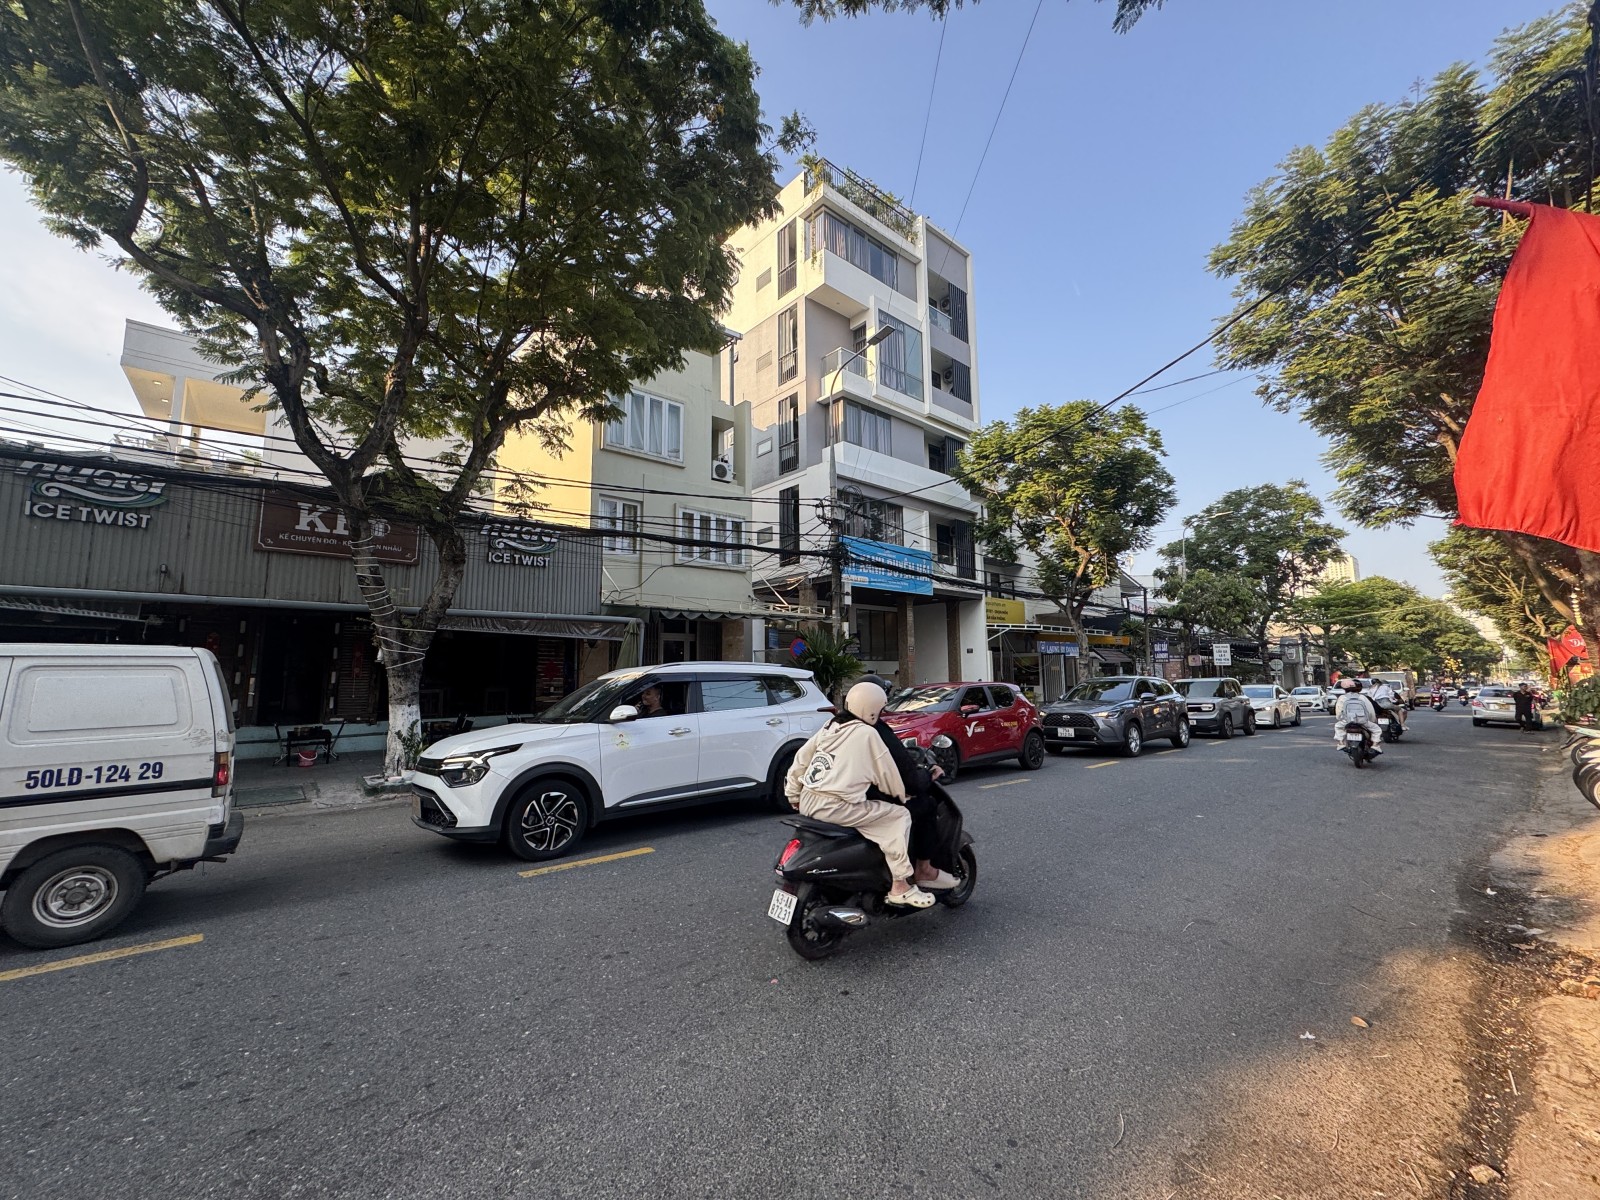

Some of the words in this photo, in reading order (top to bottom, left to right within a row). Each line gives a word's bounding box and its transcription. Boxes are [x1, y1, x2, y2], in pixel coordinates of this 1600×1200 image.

[24, 500, 71, 520] ICE
[78, 506, 151, 529] TWIST
[488, 552, 510, 564] ICE
[514, 554, 550, 567] TWIST
[138, 762, 164, 780] 29
